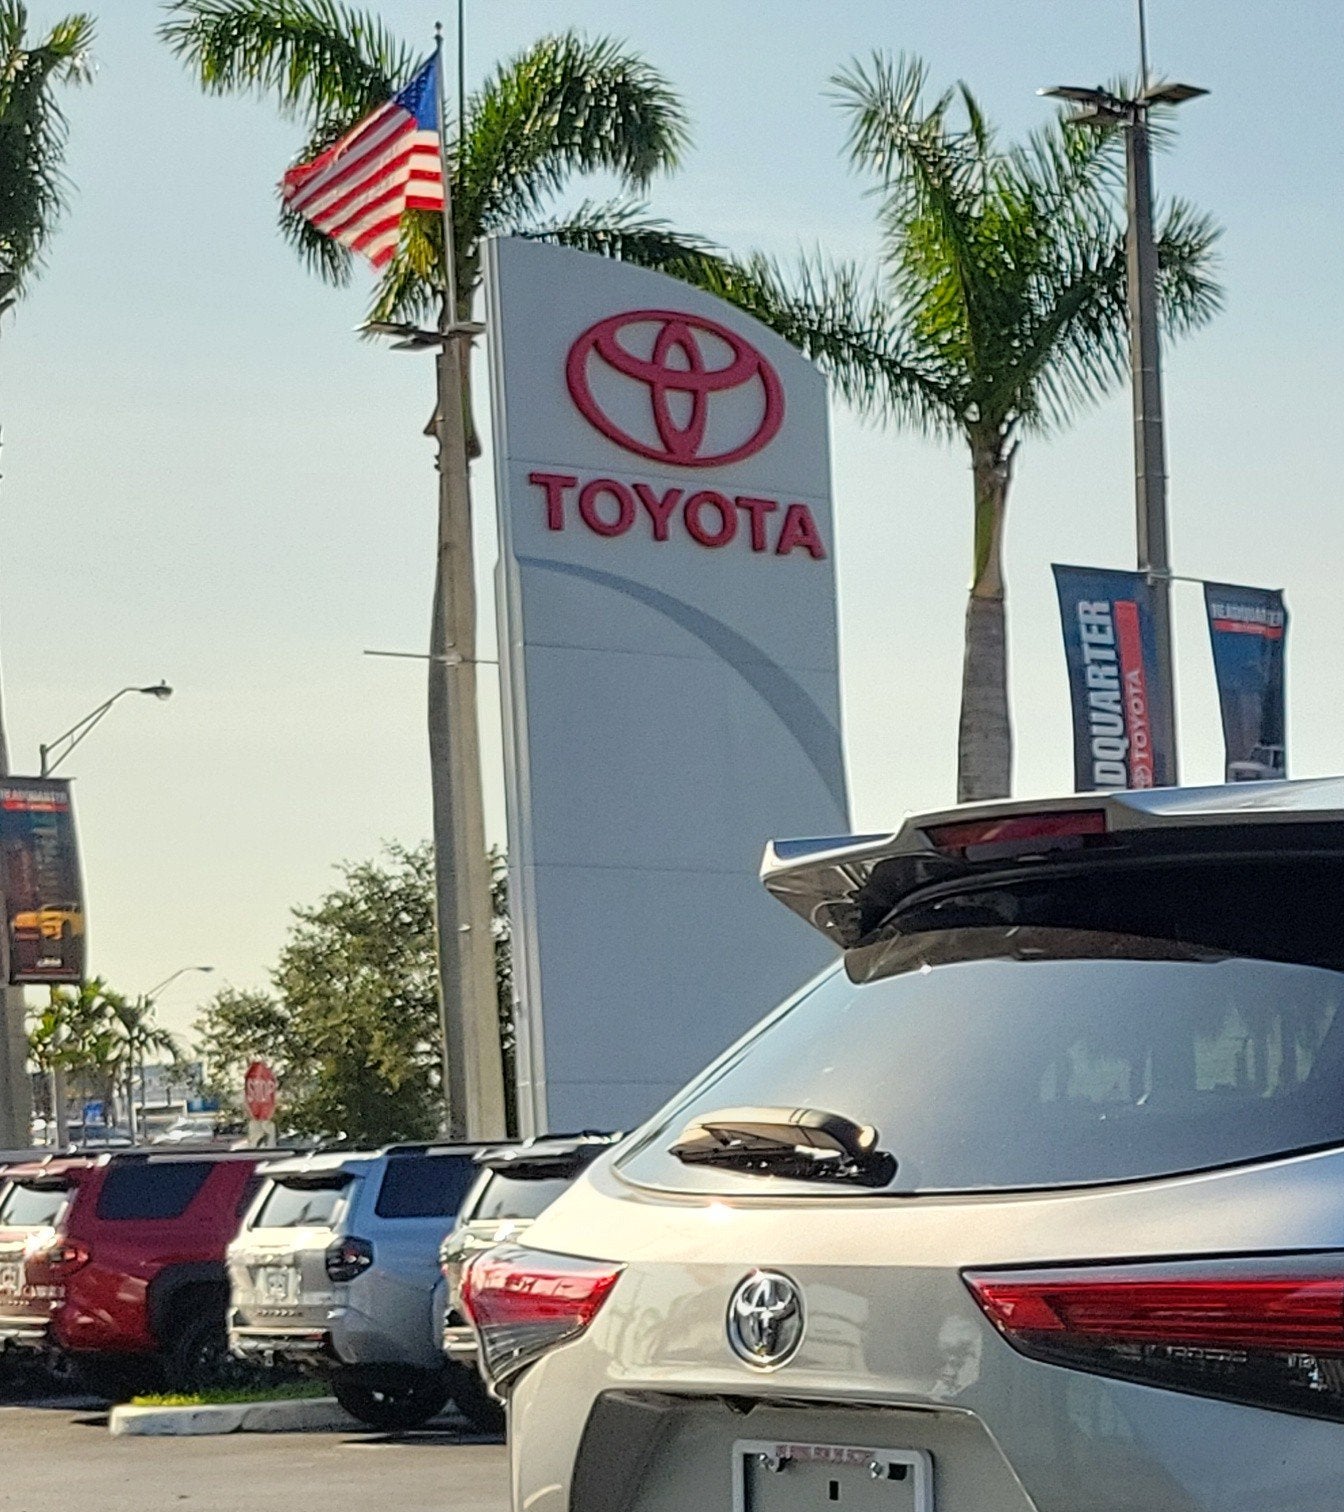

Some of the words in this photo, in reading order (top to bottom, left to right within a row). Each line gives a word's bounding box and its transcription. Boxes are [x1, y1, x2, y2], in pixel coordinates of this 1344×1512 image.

[529, 472, 826, 560] TOYOTA
[1078, 601, 1131, 789] DQUARTER
[1125, 670, 1151, 760] TOYOTA
